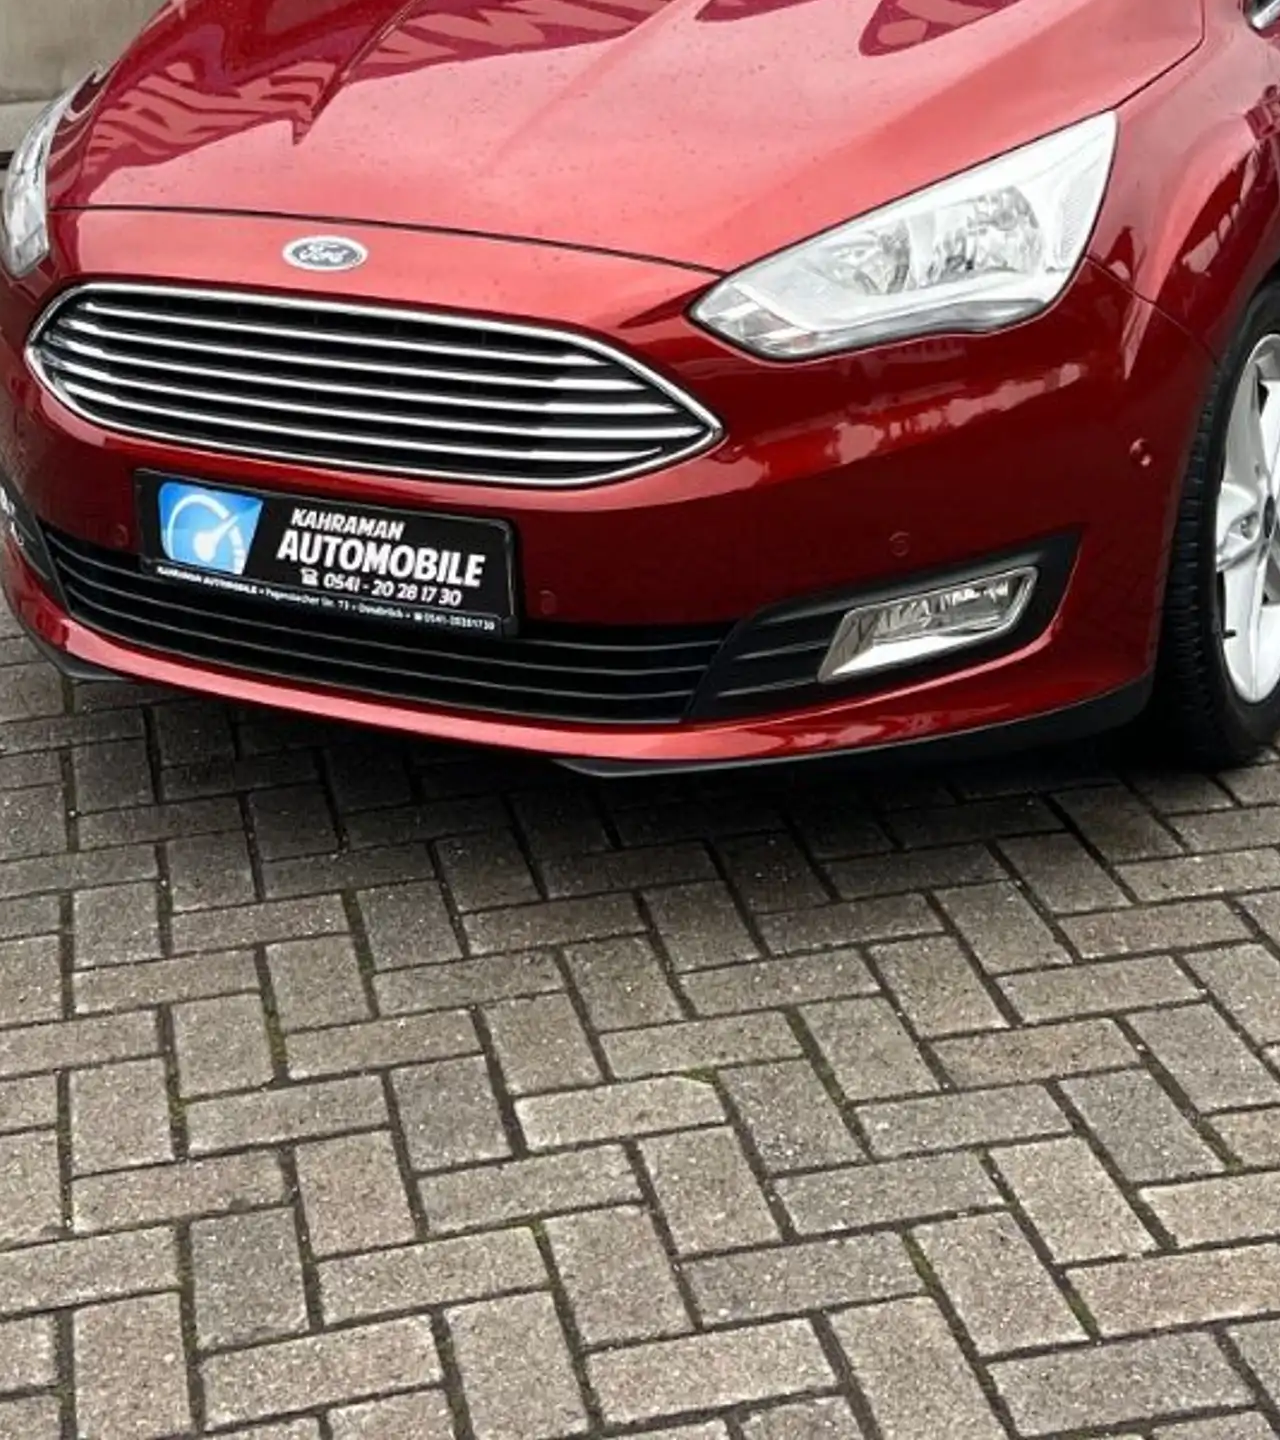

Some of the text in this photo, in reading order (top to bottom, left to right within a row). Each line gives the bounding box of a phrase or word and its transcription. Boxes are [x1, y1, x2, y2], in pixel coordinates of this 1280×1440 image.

[290, 507, 405, 542] KAHRAMAN
[276, 528, 487, 588] AUTOMOBILE
[323, 572, 361, 593] 0541
[371, 578, 395, 598] 20
[396, 582, 419, 602] 28
[420, 585, 438, 603] 17
[438, 587, 463, 607] 30
